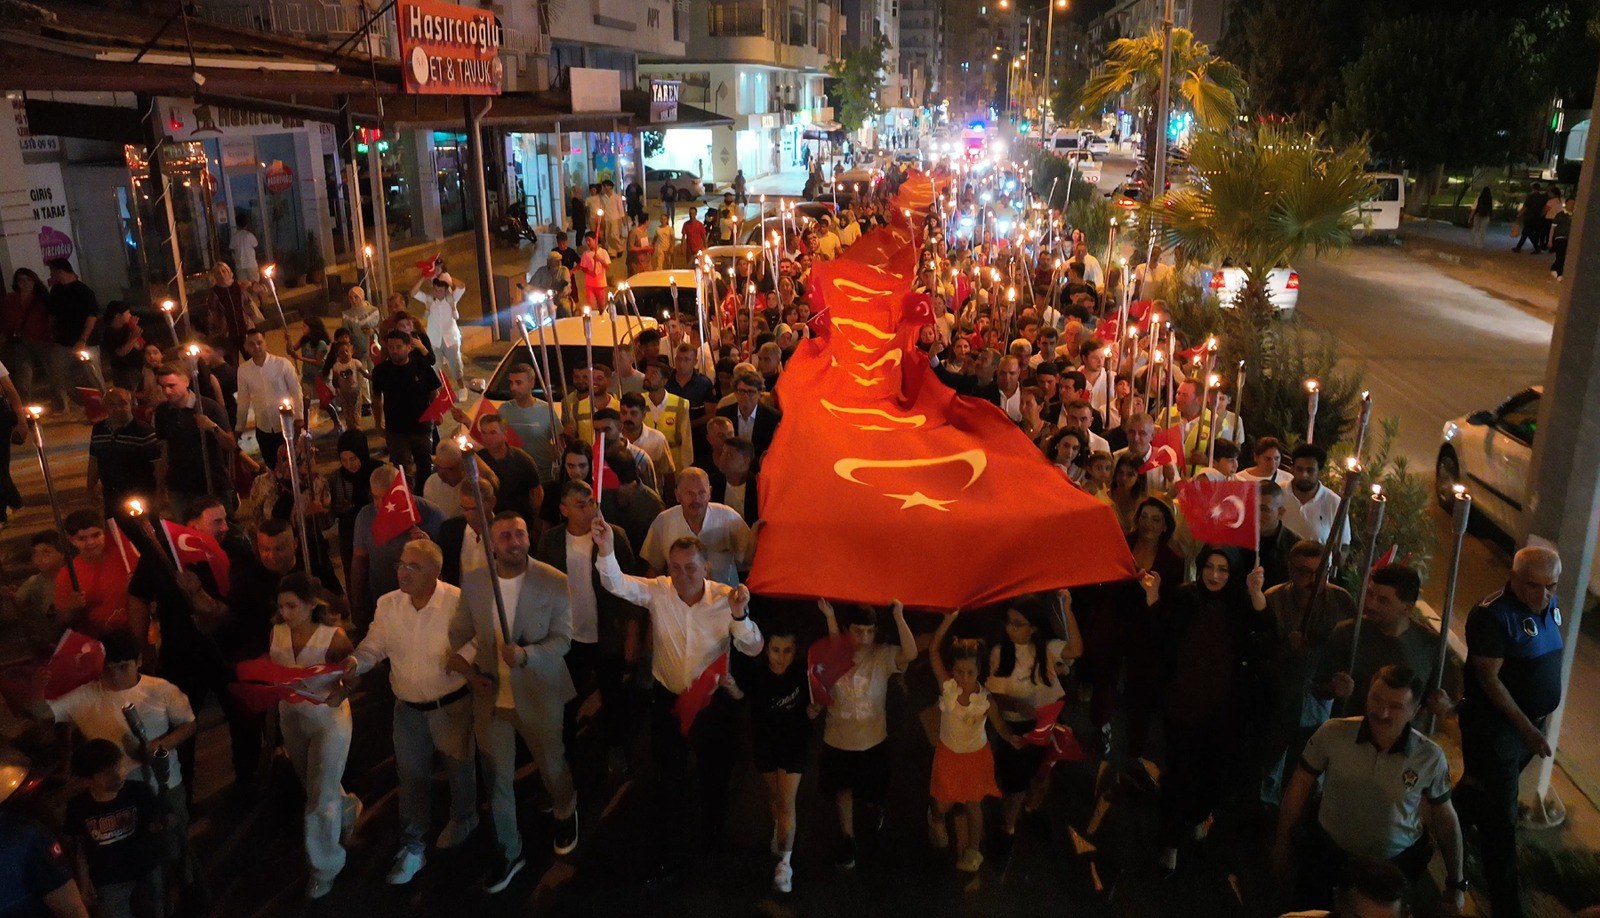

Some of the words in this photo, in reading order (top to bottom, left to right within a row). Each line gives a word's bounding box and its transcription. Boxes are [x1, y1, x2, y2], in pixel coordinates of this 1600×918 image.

[646, 7, 661, 29] APT
[409, 5, 500, 54] Hasırcıoğlu
[429, 56, 443, 81] ET
[446, 57, 456, 82] &
[457, 59, 492, 84] TAVUK
[652, 84, 679, 102] YAREN
[41, 204, 66, 220] TARAF
